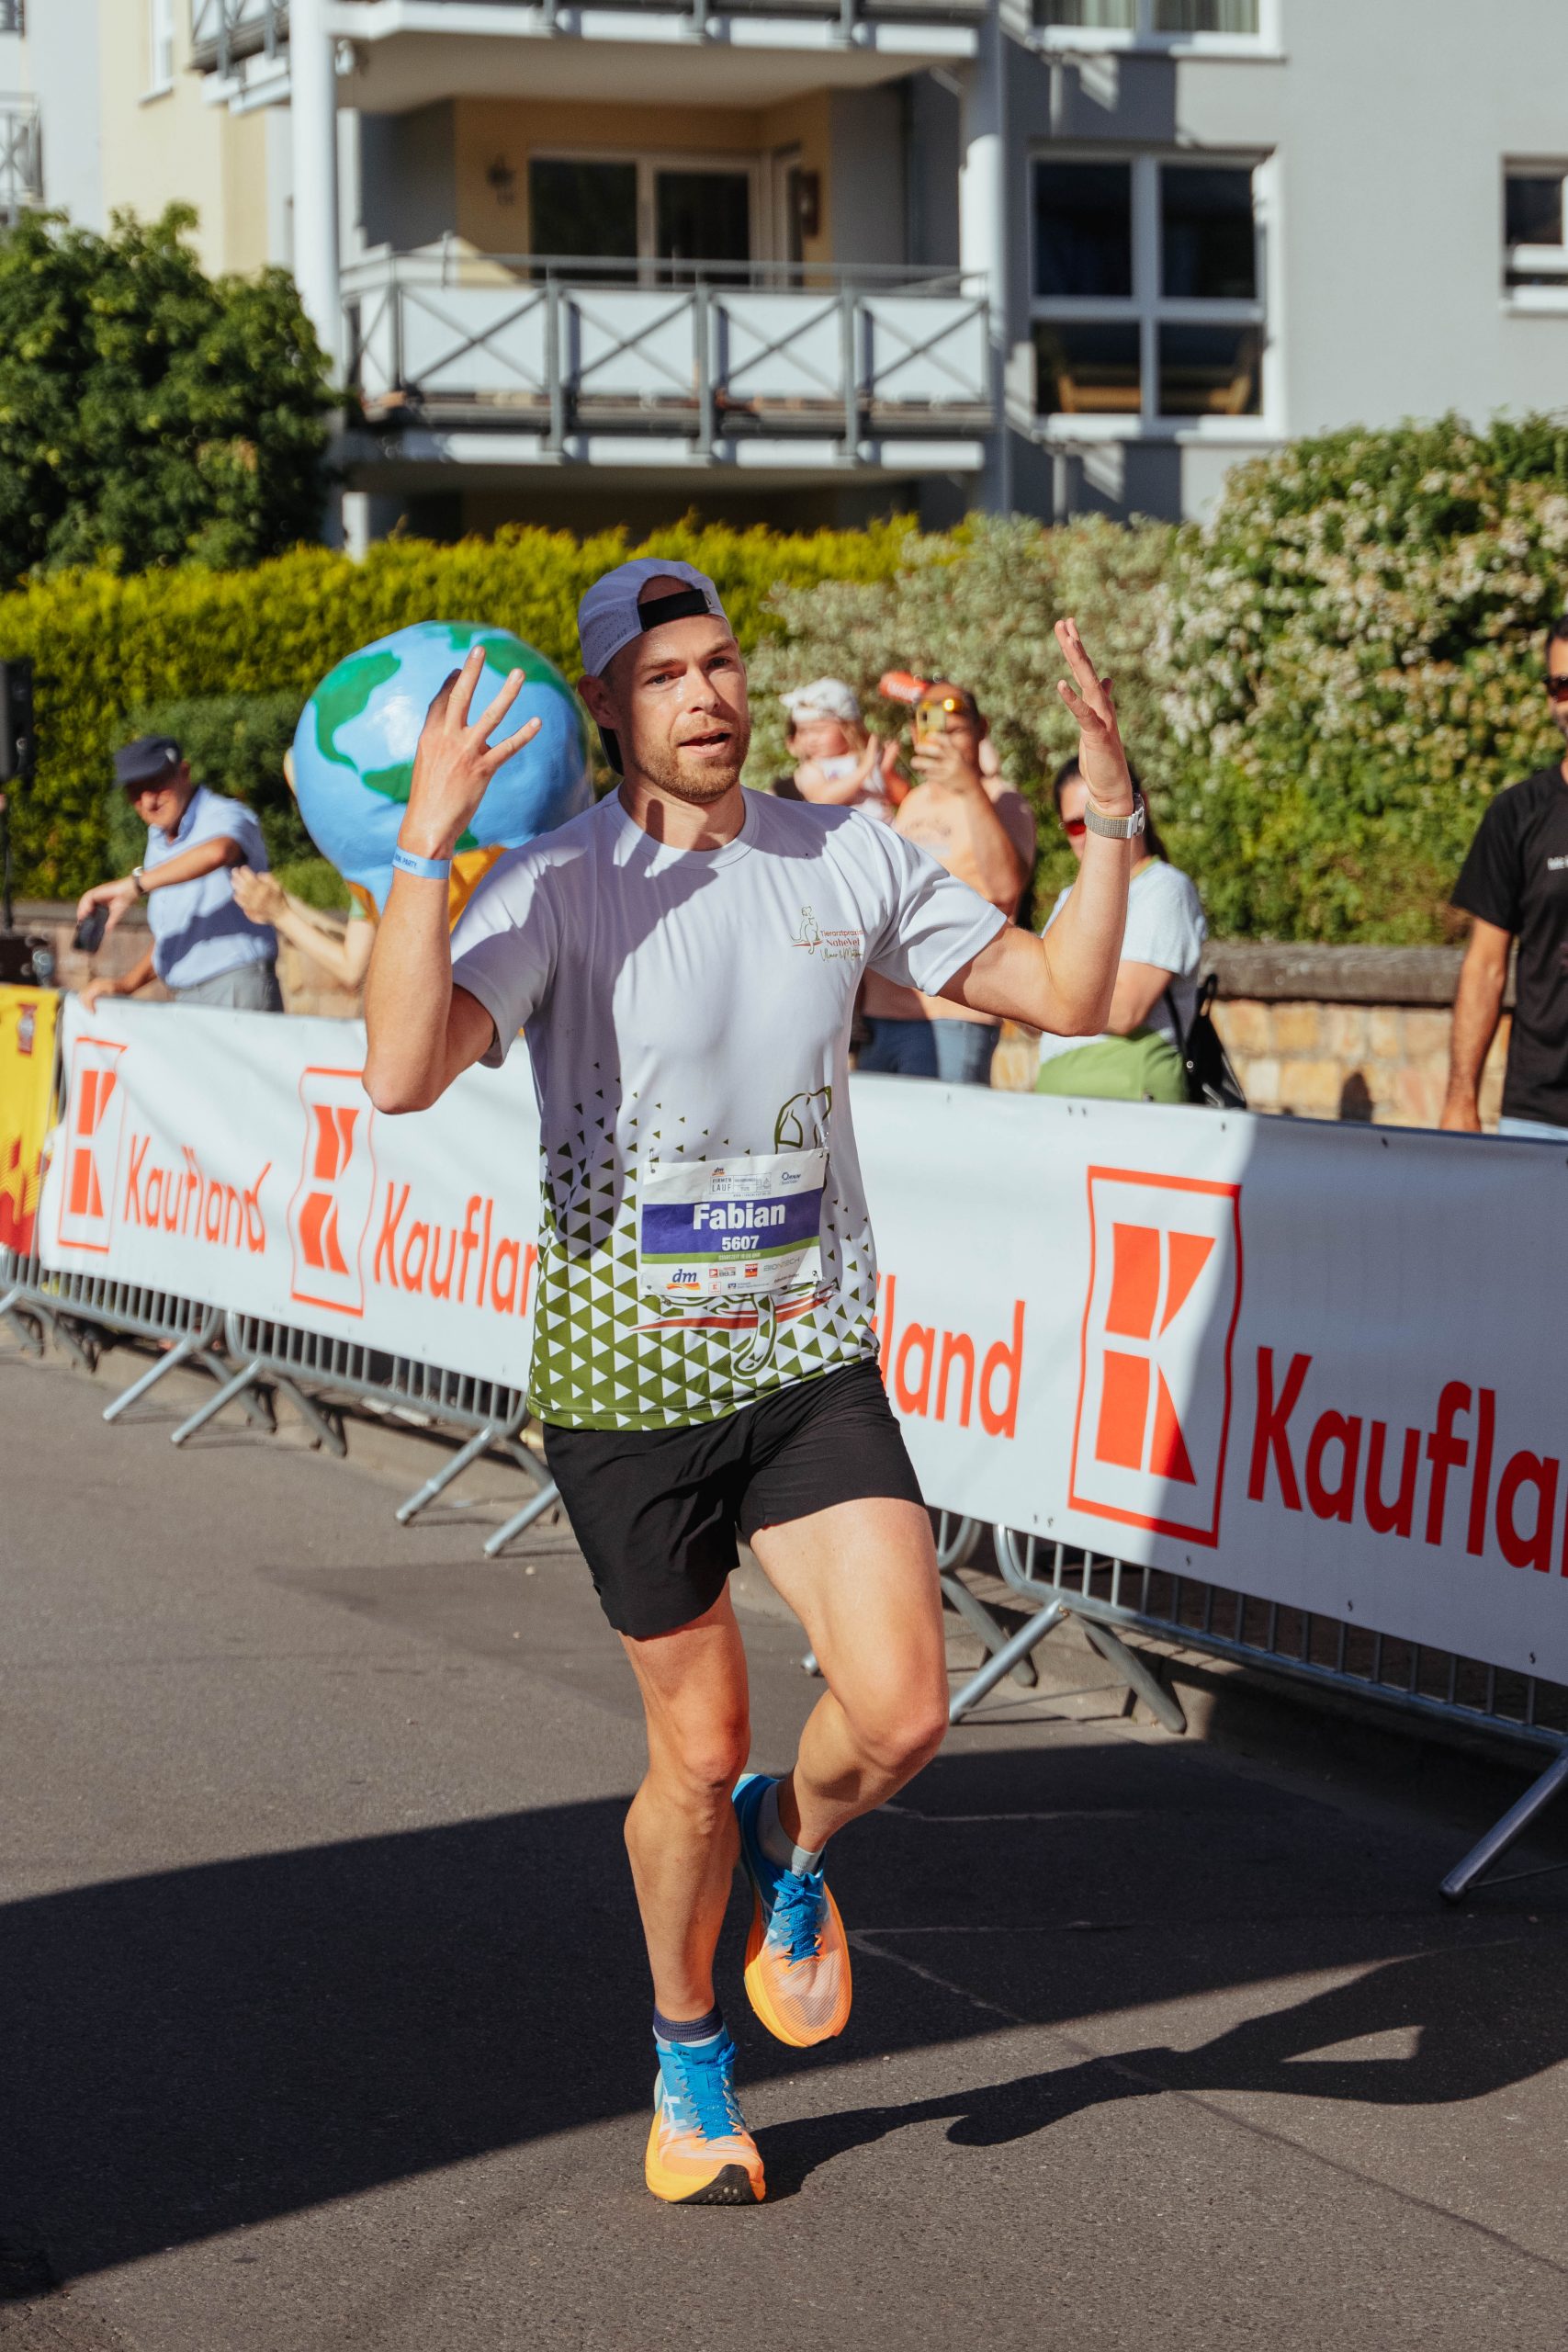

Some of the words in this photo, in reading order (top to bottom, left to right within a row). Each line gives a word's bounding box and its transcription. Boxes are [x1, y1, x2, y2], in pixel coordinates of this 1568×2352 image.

[712, 1184, 732, 1193] LAUF
[693, 1202, 785, 1231] Fabian
[721, 1236, 760, 1251] 5607
[671, 1269, 697, 1283] dm
[869, 1271, 1026, 1440] land
[1247, 1345, 1568, 1579] Kaufla
